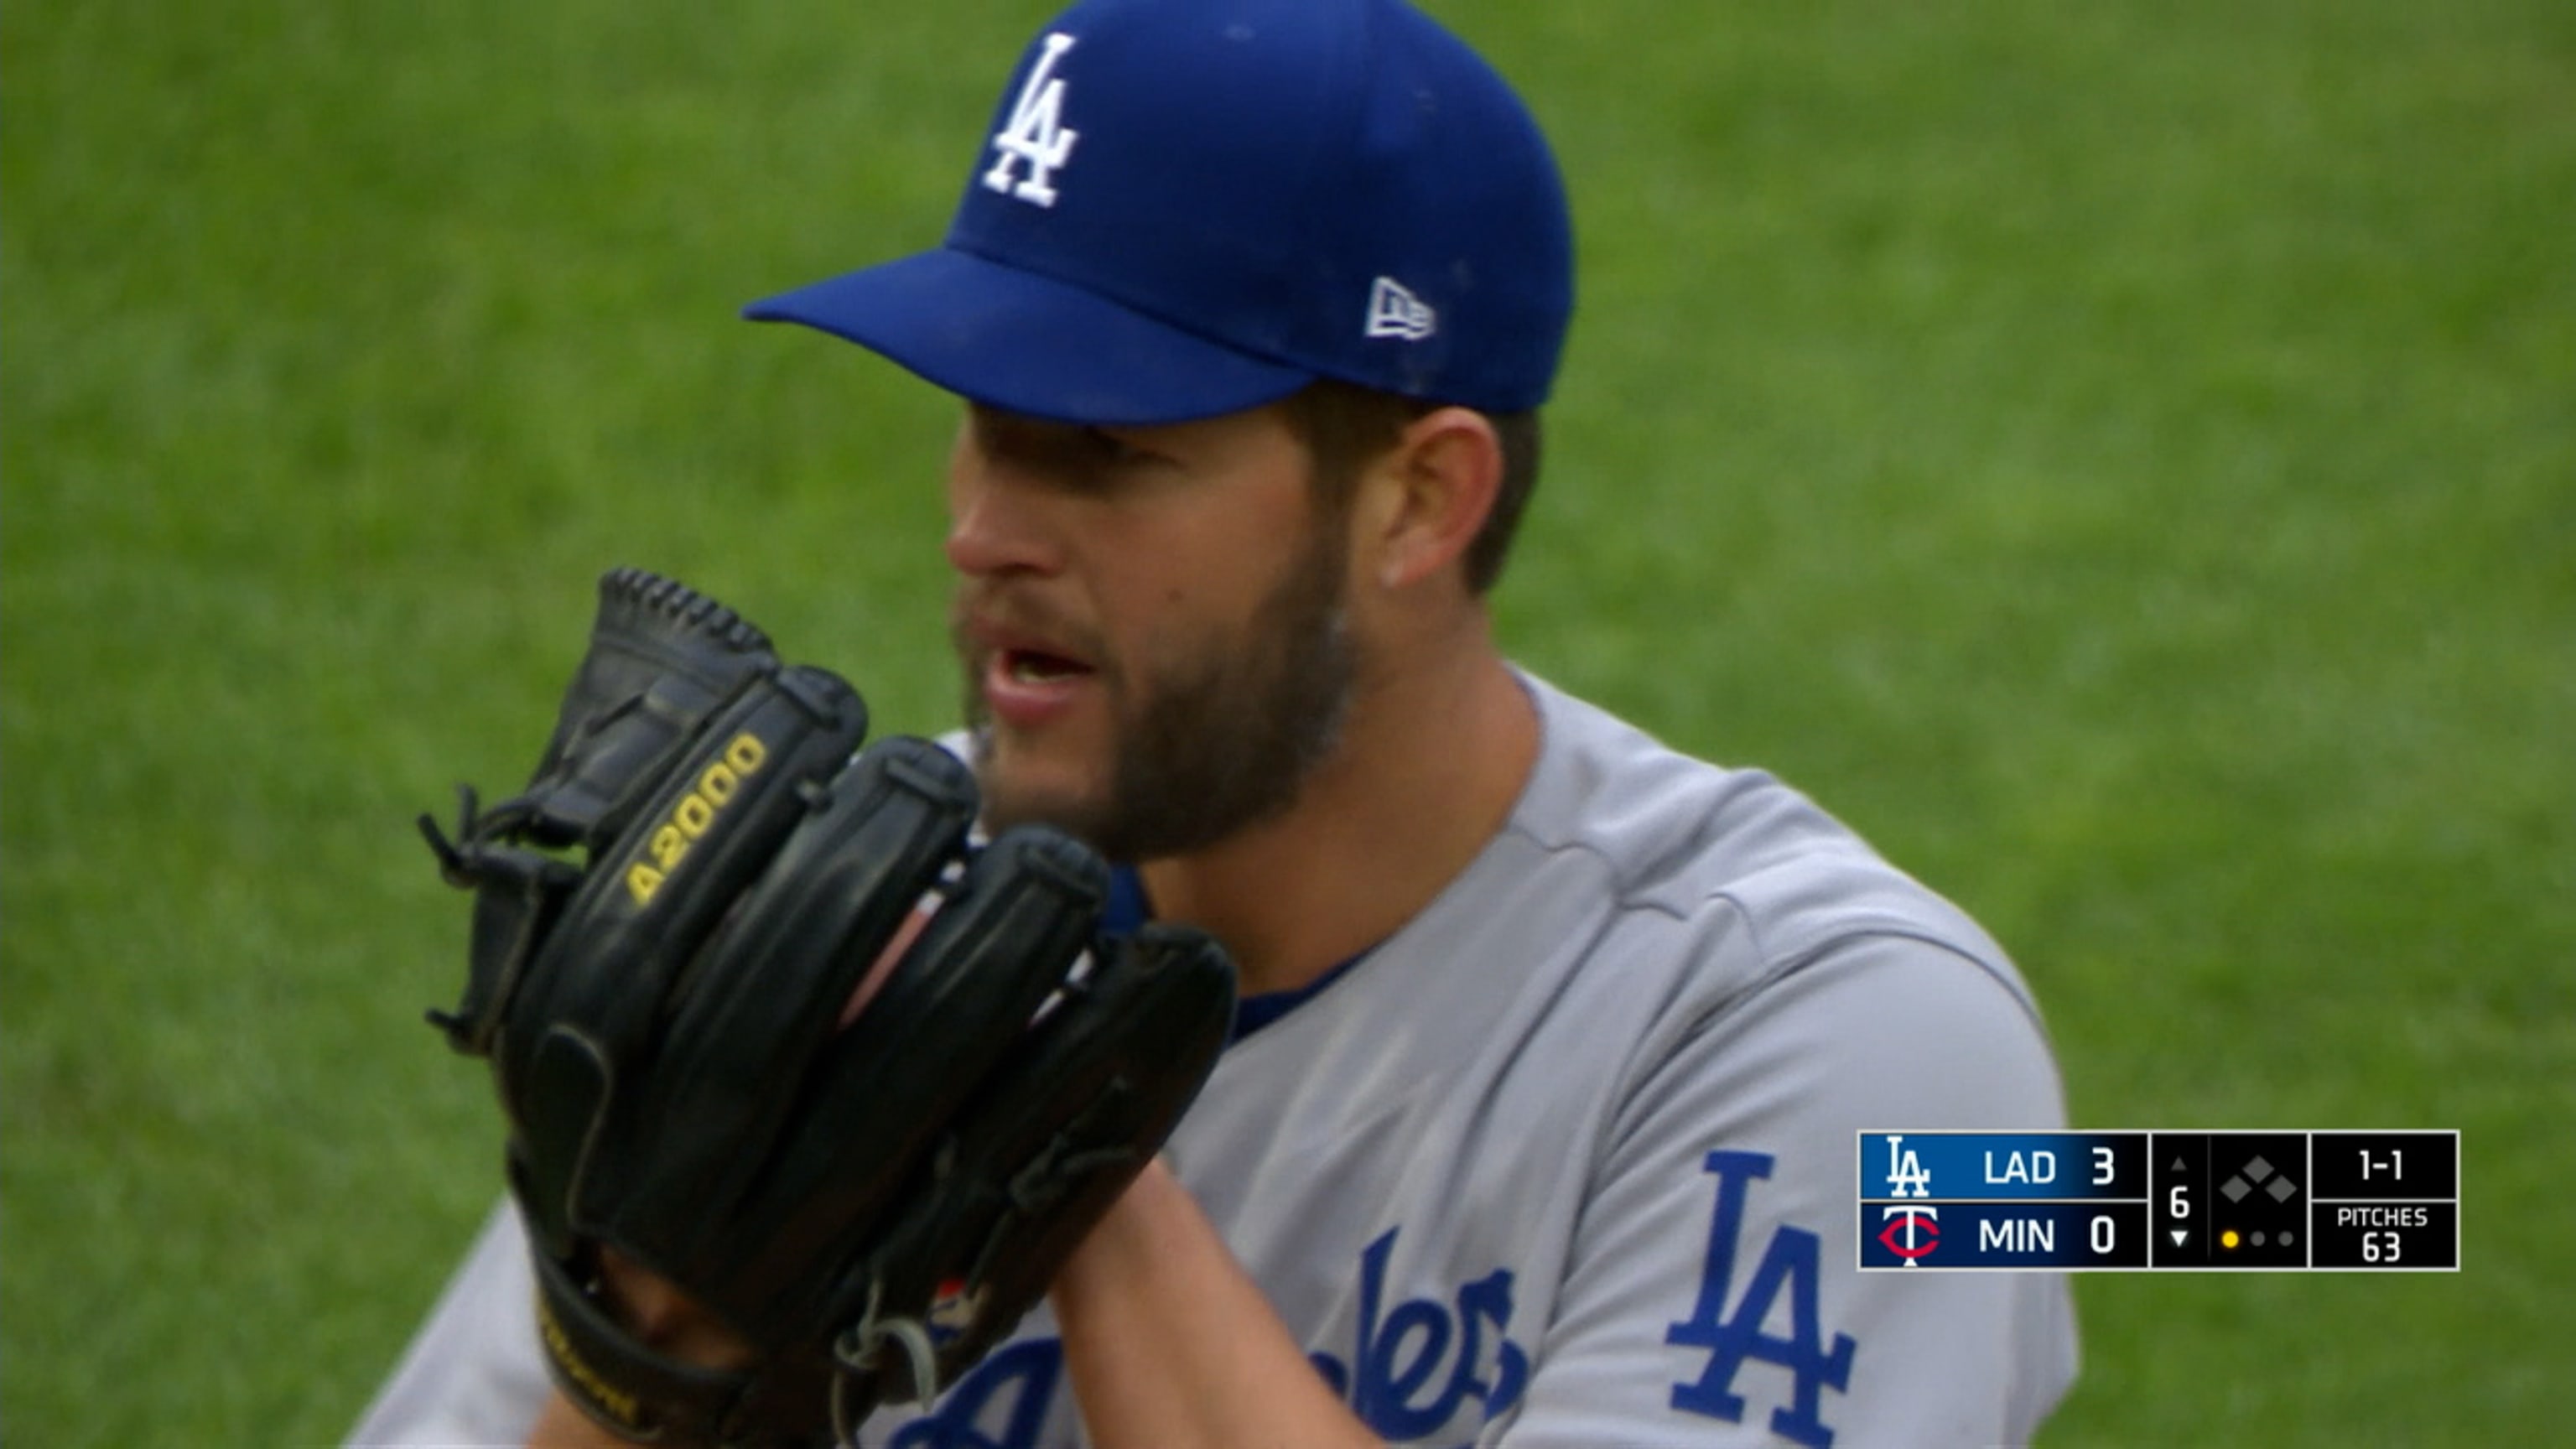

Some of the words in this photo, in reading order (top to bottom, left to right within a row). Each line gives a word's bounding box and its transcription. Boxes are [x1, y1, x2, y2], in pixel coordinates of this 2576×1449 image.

[982, 31, 1079, 208] LA
[626, 732, 766, 906] A2000
[1665, 1150, 1857, 1449] LA
